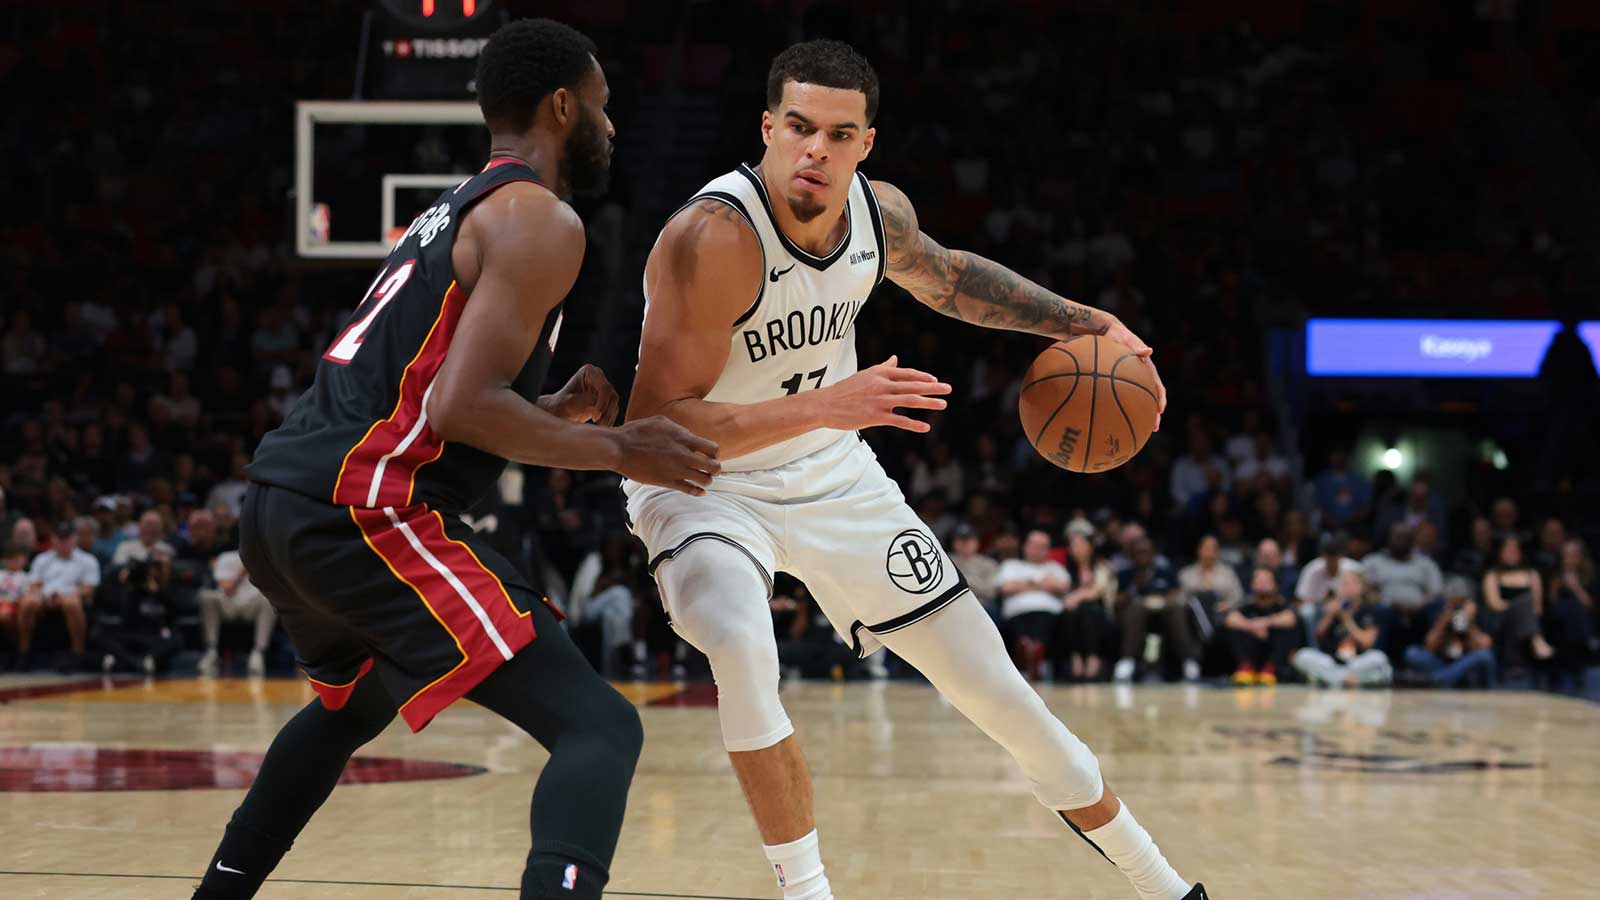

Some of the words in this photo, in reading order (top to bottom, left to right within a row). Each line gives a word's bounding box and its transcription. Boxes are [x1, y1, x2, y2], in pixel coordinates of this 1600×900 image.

[322, 259, 416, 365] 2
[743, 301, 860, 363] BROOKLY
[901, 540, 932, 585] B
